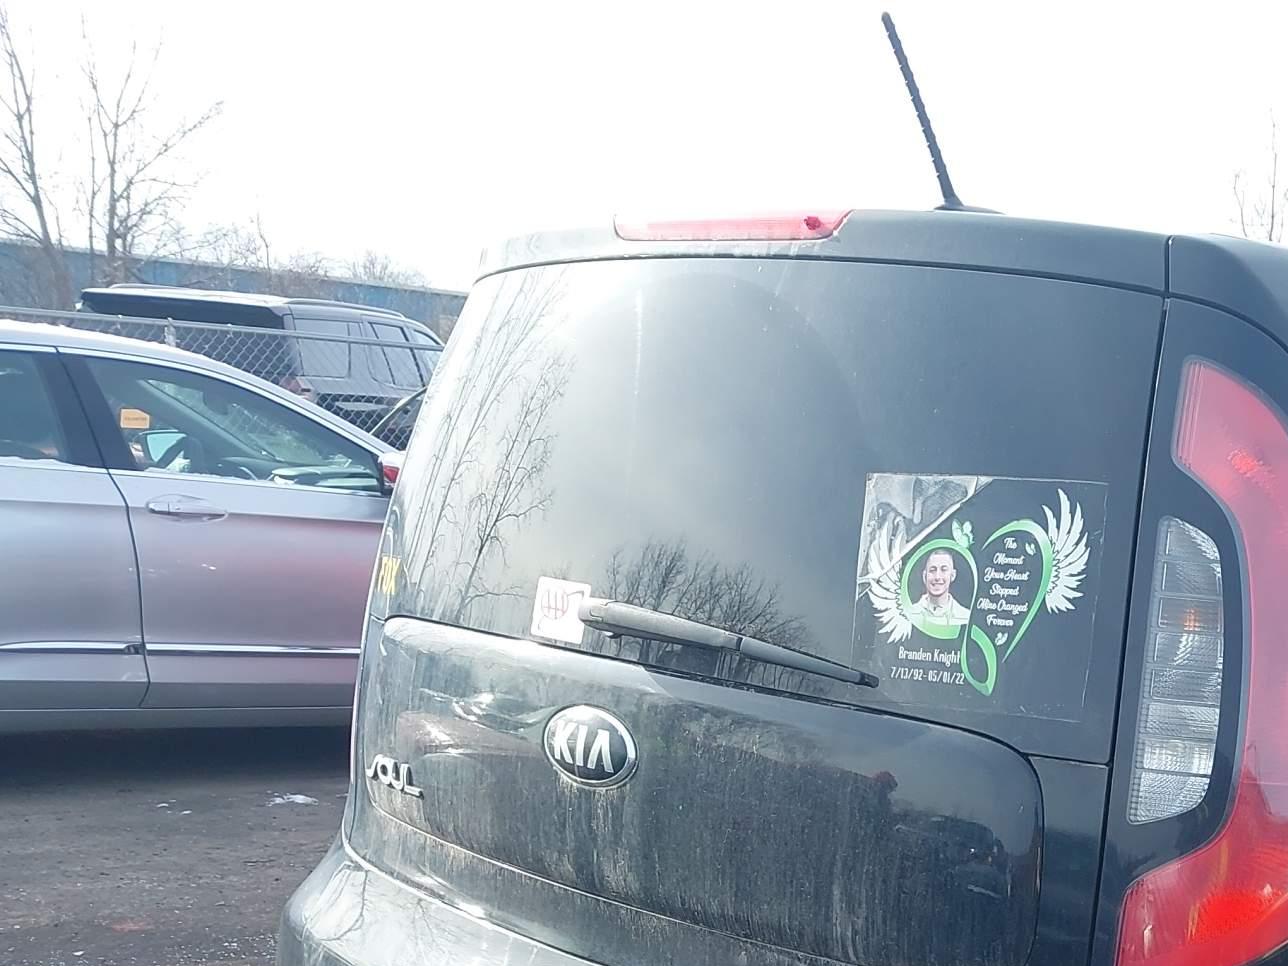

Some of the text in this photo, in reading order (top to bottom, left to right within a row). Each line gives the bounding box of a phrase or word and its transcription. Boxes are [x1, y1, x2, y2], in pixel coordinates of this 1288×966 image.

[1003, 537, 1017, 549] The
[993, 552, 1025, 565] Moment
[989, 583, 1020, 598] Stopped
[898, 645, 960, 668] Branden Knight
[553, 719, 615, 773] KIA
[365, 753, 424, 800] SOUL
